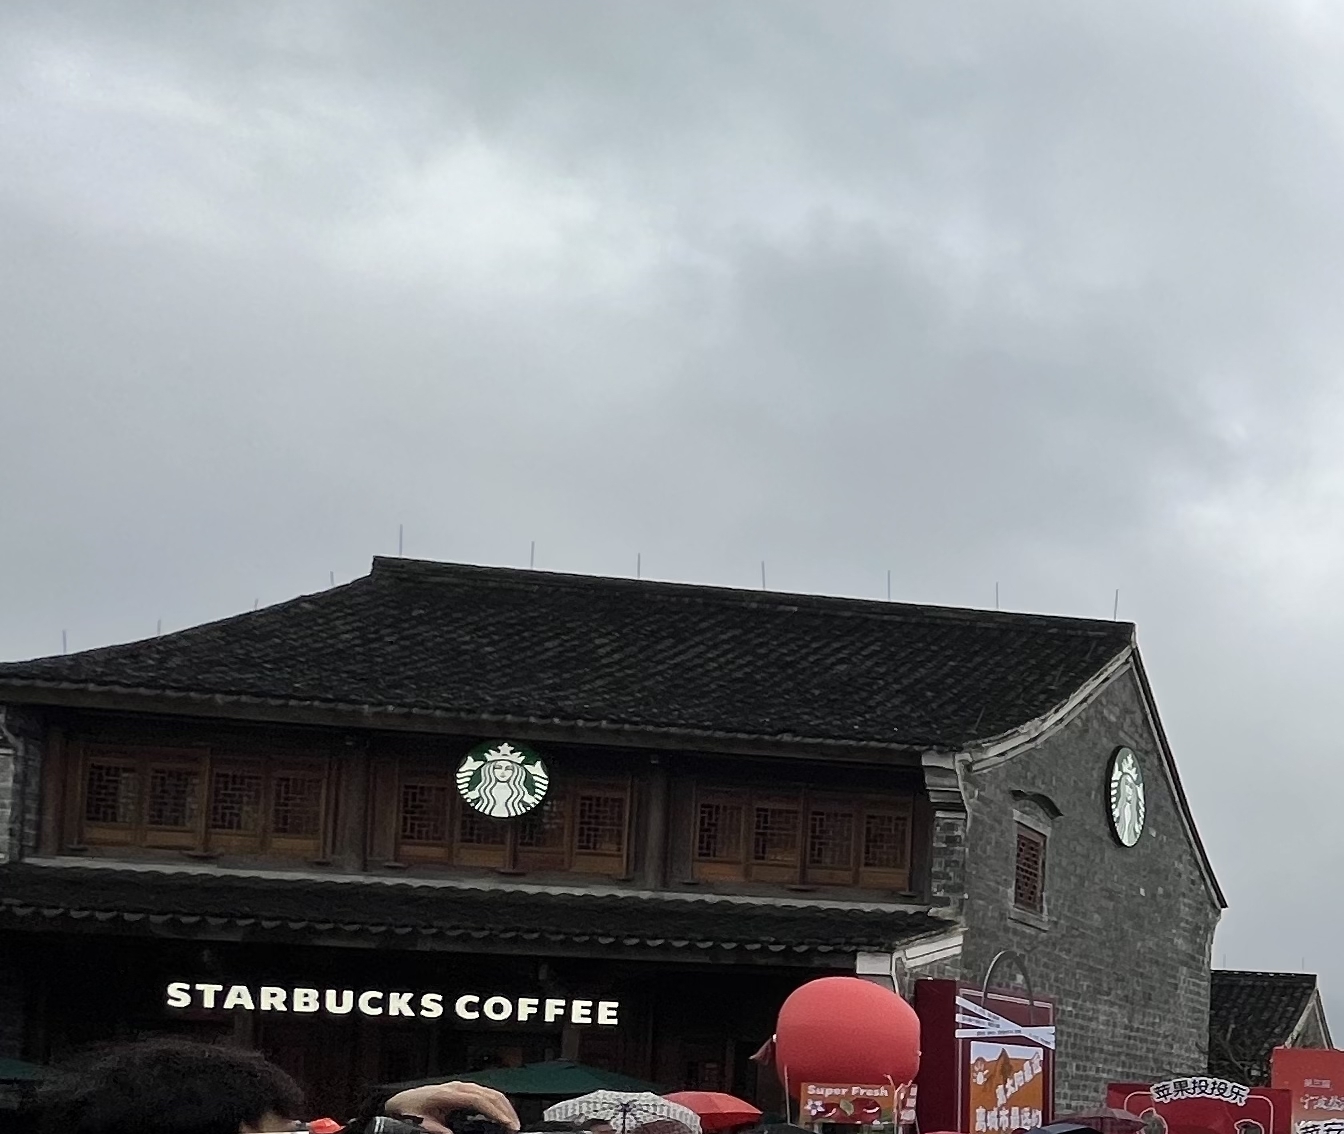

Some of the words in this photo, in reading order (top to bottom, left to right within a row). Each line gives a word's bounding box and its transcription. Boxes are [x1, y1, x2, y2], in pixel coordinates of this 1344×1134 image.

[166, 981, 444, 1019] STARBUCKS
[455, 994, 620, 1025] COFFEE
[807, 1084, 848, 1097] Super
[851, 1085, 889, 1097] Fresh
[1153, 1079, 1248, 1104] 苹果投投乐
